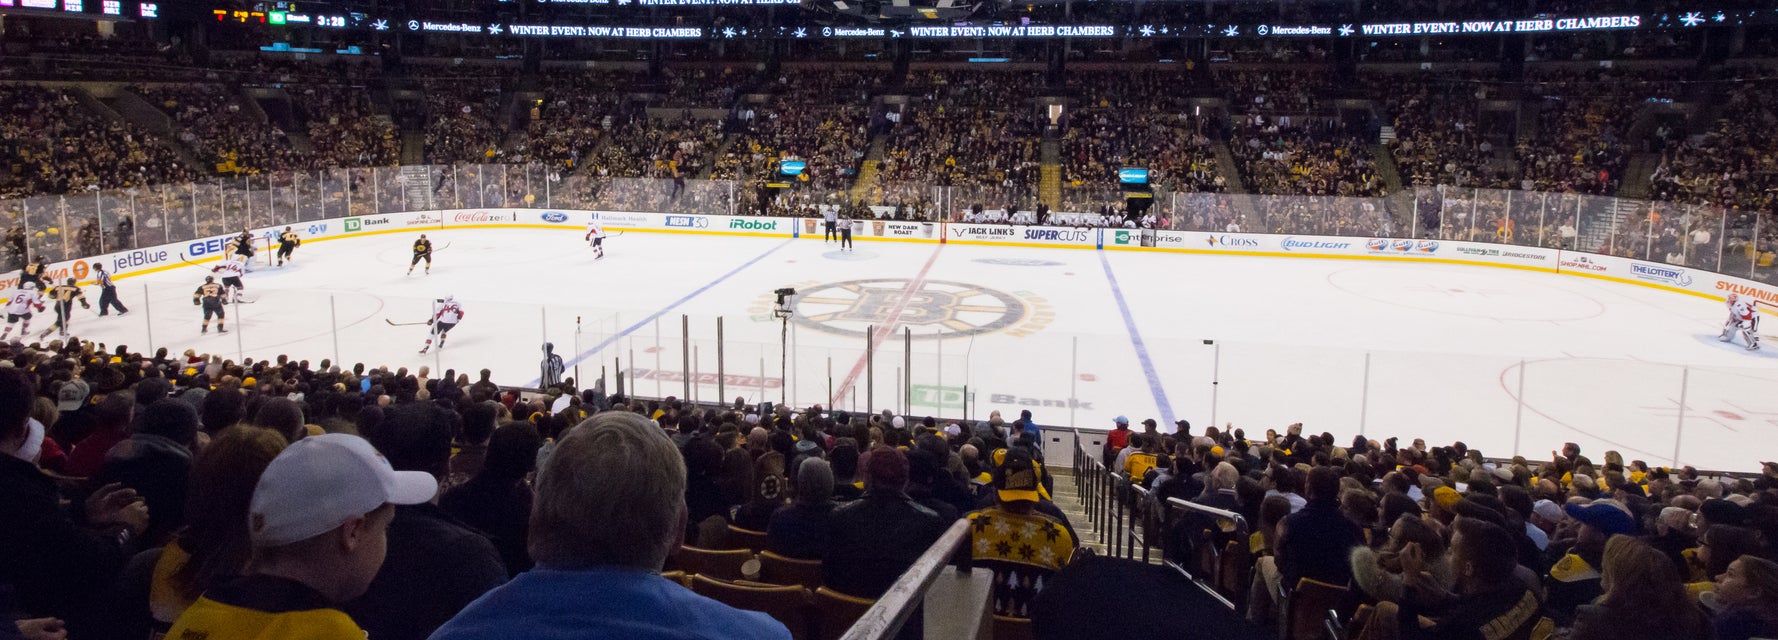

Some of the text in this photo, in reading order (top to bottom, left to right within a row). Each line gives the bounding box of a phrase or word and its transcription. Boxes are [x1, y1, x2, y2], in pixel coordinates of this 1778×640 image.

[286, 14, 310, 22] Bank
[317, 15, 345, 27] 3:28
[423, 22, 481, 32] Mercedes-Benz
[1272, 26, 1331, 35] Mercedes-Benz
[1362, 16, 1640, 34] WINTER EVENT: NOW AT HERB CHAMBERS
[510, 25, 701, 37] WINTER EVENT: NOW AT HERB CHAMBERS
[835, 28, 884, 36] Mercedes-Benz
[911, 26, 1114, 36] WINTER EVENT: NOW AT HERB CHAMBERS
[545, 213, 564, 221] Ford
[671, 217, 690, 226] NESN
[346, 217, 390, 230] TD Bank
[729, 219, 777, 230] iRobot
[968, 227, 1015, 236] JACK LINK'S
[1024, 228, 1088, 242] SUPERCUTS
[1118, 231, 1183, 245] enterprise
[1286, 239, 1351, 249] BUD LIGHT
[1502, 250, 1546, 261] BRIDGESTONE
[113, 250, 168, 274] jetBlue
[1632, 264, 1647, 275] THE
[1649, 266, 1680, 280] LOTTERY
[15, 294, 26, 305] 6
[989, 393, 1095, 410] Bank
